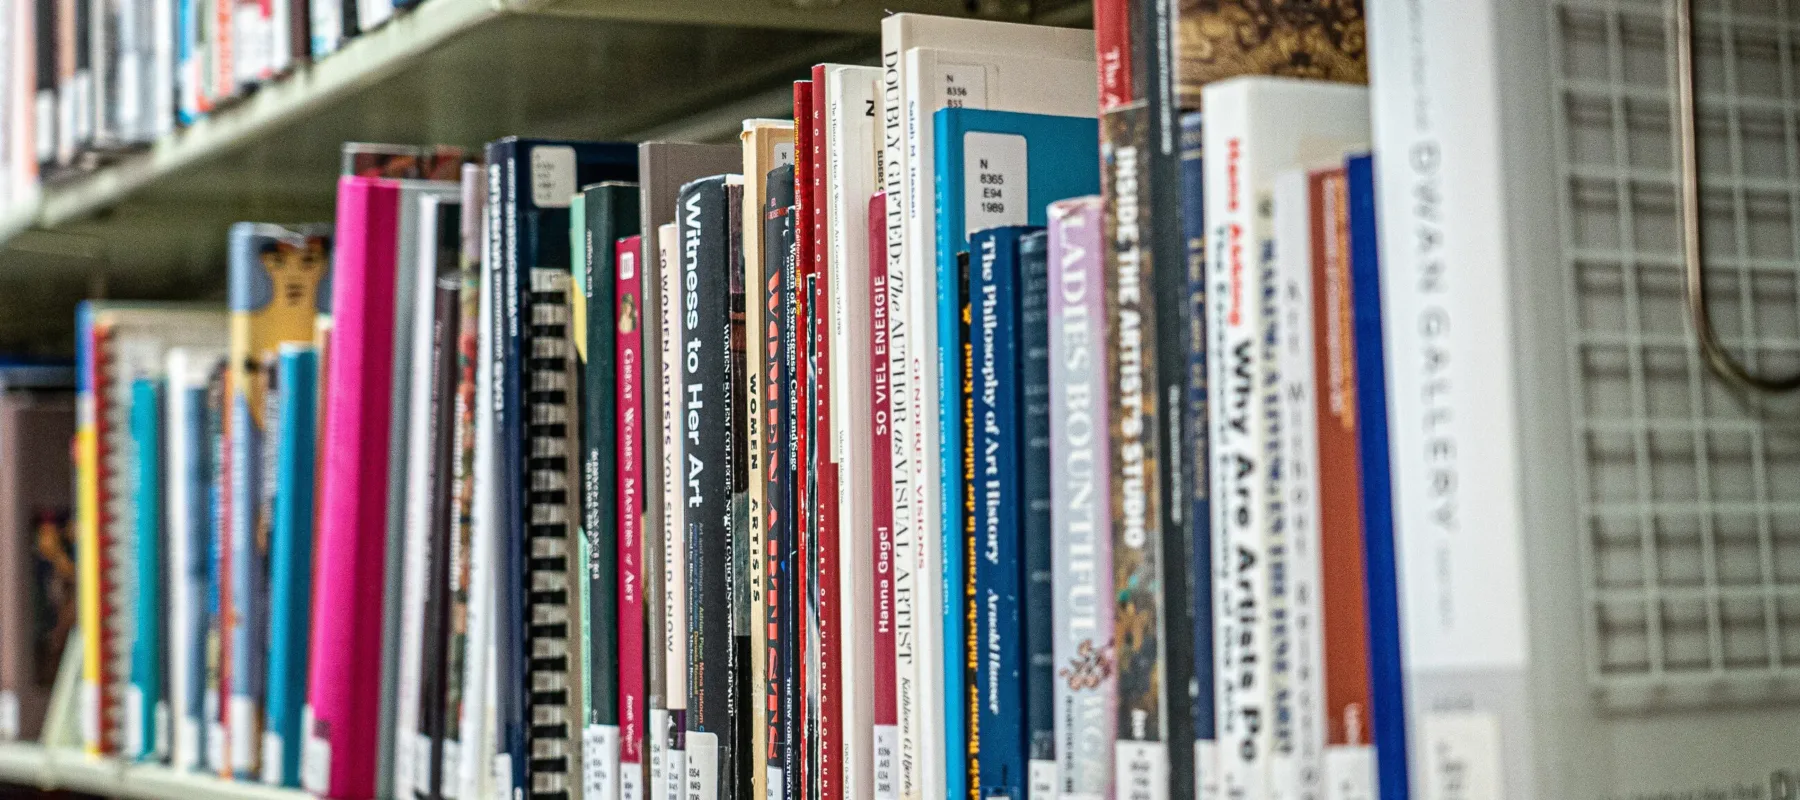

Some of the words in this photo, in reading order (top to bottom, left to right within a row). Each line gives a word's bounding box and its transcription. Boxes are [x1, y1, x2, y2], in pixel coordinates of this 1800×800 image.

[884, 50, 900, 150] DOUBLY
[946, 75, 953, 83] N
[946, 87, 966, 97] 8356
[794, 178, 801, 187] of
[979, 159, 988, 169] N
[980, 174, 1004, 185] 8365
[983, 188, 1002, 198] E94
[887, 160, 902, 268] GIFTED:
[980, 203, 1004, 214] 1989
[1116, 145, 1138, 245] INSIDE
[1409, 138, 1446, 295] DWAN
[660, 248, 668, 270] 50
[685, 190, 702, 330] Witness
[789, 243, 798, 289] Women
[795, 227, 803, 268] California
[981, 235, 996, 282] The
[1116, 246, 1140, 306] THE
[1227, 223, 1245, 327] Abbing
[661, 273, 670, 354] WOMEN
[790, 291, 798, 304] of
[874, 275, 886, 356] ENERGIE
[890, 273, 904, 312] The
[1059, 215, 1088, 372] LADIES
[685, 337, 702, 374] to
[723, 322, 731, 373] WOMEN
[790, 304, 799, 377] Sweetgrass,
[982, 285, 998, 406] Philosophy
[767, 268, 780, 486] WOMEN
[791, 379, 799, 417] Cedar
[875, 362, 886, 404] VIEL
[890, 317, 906, 424] AUTHOR
[1120, 309, 1143, 437] ARTIST'S
[1230, 339, 1256, 435] Why
[664, 360, 672, 445] ARTISTS
[687, 383, 703, 446] Her
[724, 382, 732, 428] SALEM
[749, 372, 757, 470] WOMEN
[791, 417, 799, 443] and
[876, 405, 886, 436] SO
[914, 357, 922, 474] GENDERED
[984, 410, 998, 433] of
[1418, 305, 1461, 533] GALLERY
[893, 428, 904, 455] as
[985, 437, 999, 475] Art
[665, 453, 673, 494] YOU
[688, 452, 704, 508] Art
[1122, 441, 1146, 548] STUDIO
[1235, 455, 1256, 530] Are
[894, 456, 911, 558] VISUAL
[917, 484, 925, 569] VISIONS
[985, 480, 1000, 564] History
[1065, 383, 1098, 645] BOUNTIFUL
[665, 500, 674, 583] SHOULD
[752, 497, 761, 604] ARTISTS
[877, 526, 890, 575] Gagel
[666, 590, 675, 653] KNOW
[820, 588, 826, 608] OF
[878, 579, 889, 634] Hanna
[897, 567, 912, 664] ARTIST
[988, 590, 1001, 649] Arnold
[1239, 546, 1259, 691] Artists
[767, 496, 780, 760] ARTISTS
[787, 721, 795, 746] YORK
[902, 676, 910, 735] Kathleen
[1239, 706, 1264, 763] Po
[787, 747, 795, 793] CULTURAL
